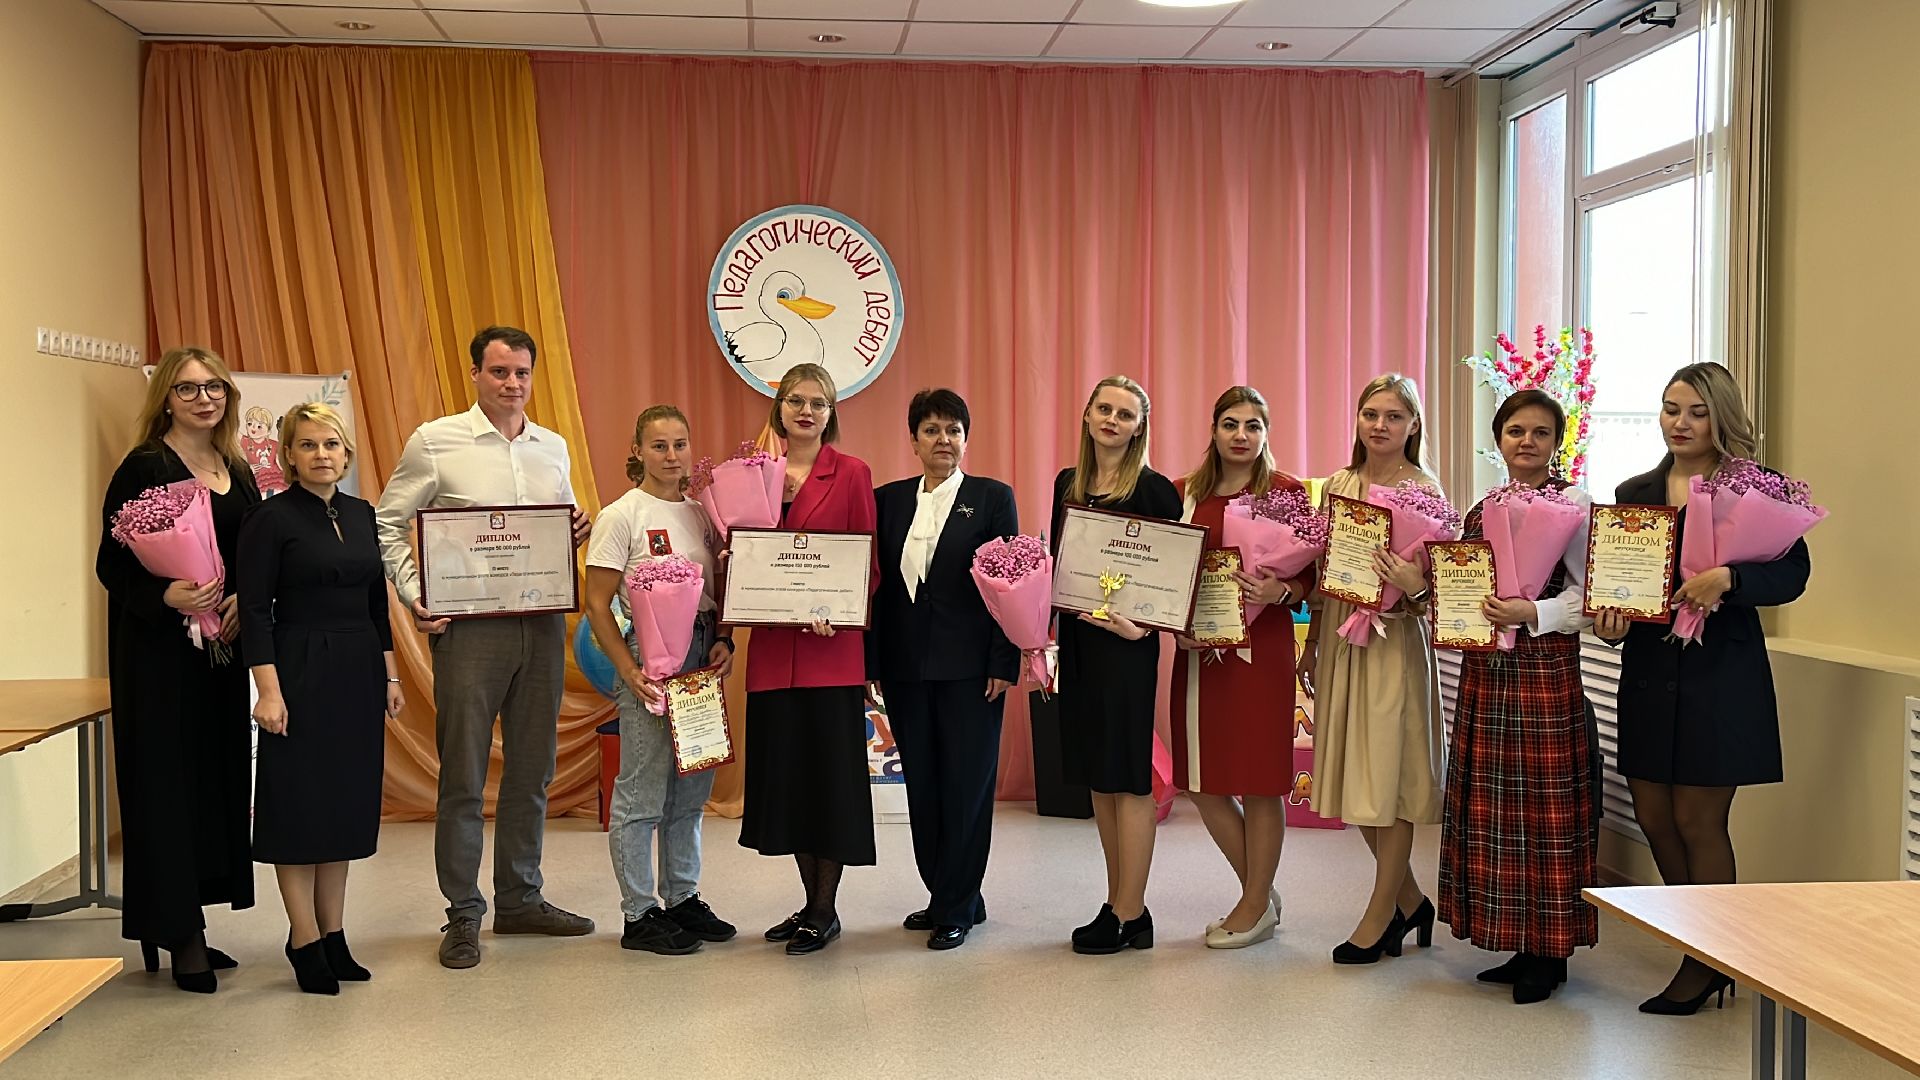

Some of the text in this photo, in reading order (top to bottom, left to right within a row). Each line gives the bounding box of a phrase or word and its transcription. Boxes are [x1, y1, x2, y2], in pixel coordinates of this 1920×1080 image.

[1337, 522, 1381, 541] ДИПЛОМ
[475, 533, 521, 544] ДИПЛОМ
[1602, 534, 1661, 547] ДИПЛОМ
[1108, 539, 1152, 553] ДИПЛОМ
[777, 552, 822, 561] ДИПЛОМ
[1441, 569, 1486, 579] ДИПЛОМ
[676, 693, 716, 710] ДИПЛОМ
